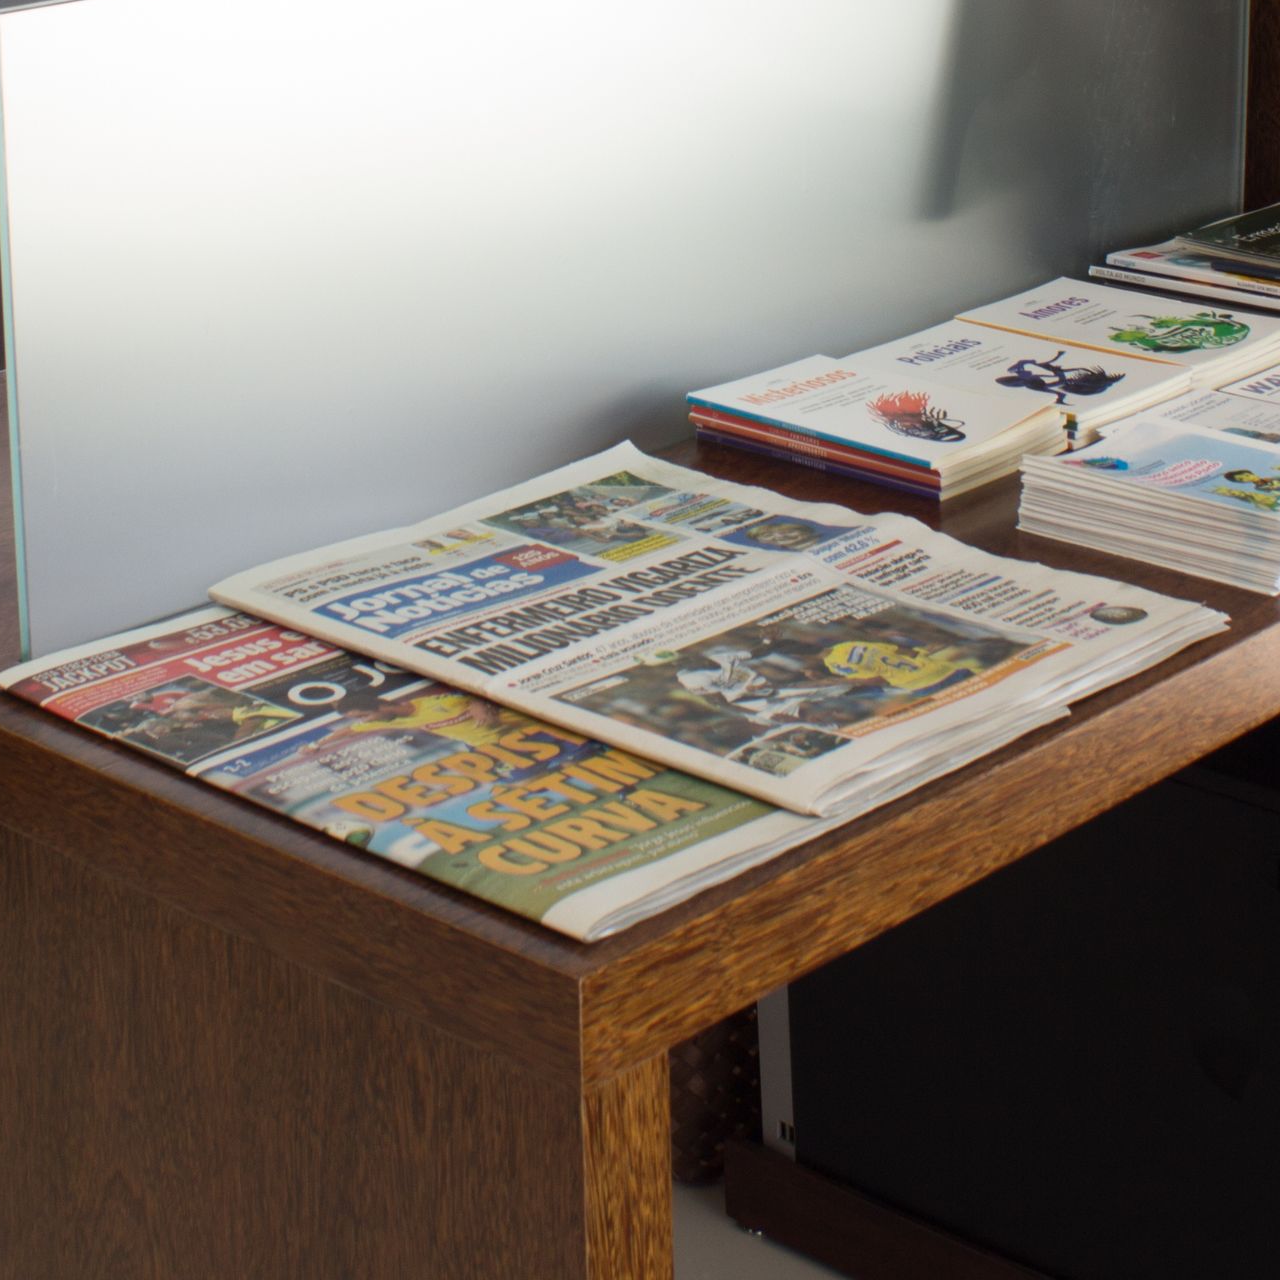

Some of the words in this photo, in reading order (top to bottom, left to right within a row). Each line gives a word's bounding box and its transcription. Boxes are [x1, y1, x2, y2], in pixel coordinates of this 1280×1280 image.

[1018, 295, 1090, 321] Amores
[896, 337, 983, 366] Policiais
[736, 368, 858, 408] Misteriosos
[326, 571, 476, 622] Jornal
[470, 564, 512, 580] de
[353, 572, 545, 633] Notícias
[412, 586, 624, 659] ENFERMEIRO
[597, 545, 749, 594] VIGARIZA
[456, 604, 656, 677] MILIONÁRIO
[631, 564, 764, 608] DOENTE
[41, 654, 137, 693] JACKPOT
[183, 637, 283, 673] Jesus
[216, 658, 278, 683] em
[270, 641, 336, 665] sar
[287, 680, 348, 705] O
[332, 724, 587, 823] DESPIST
[466, 746, 668, 830] SÉTIM
[477, 788, 708, 877] CURVA
